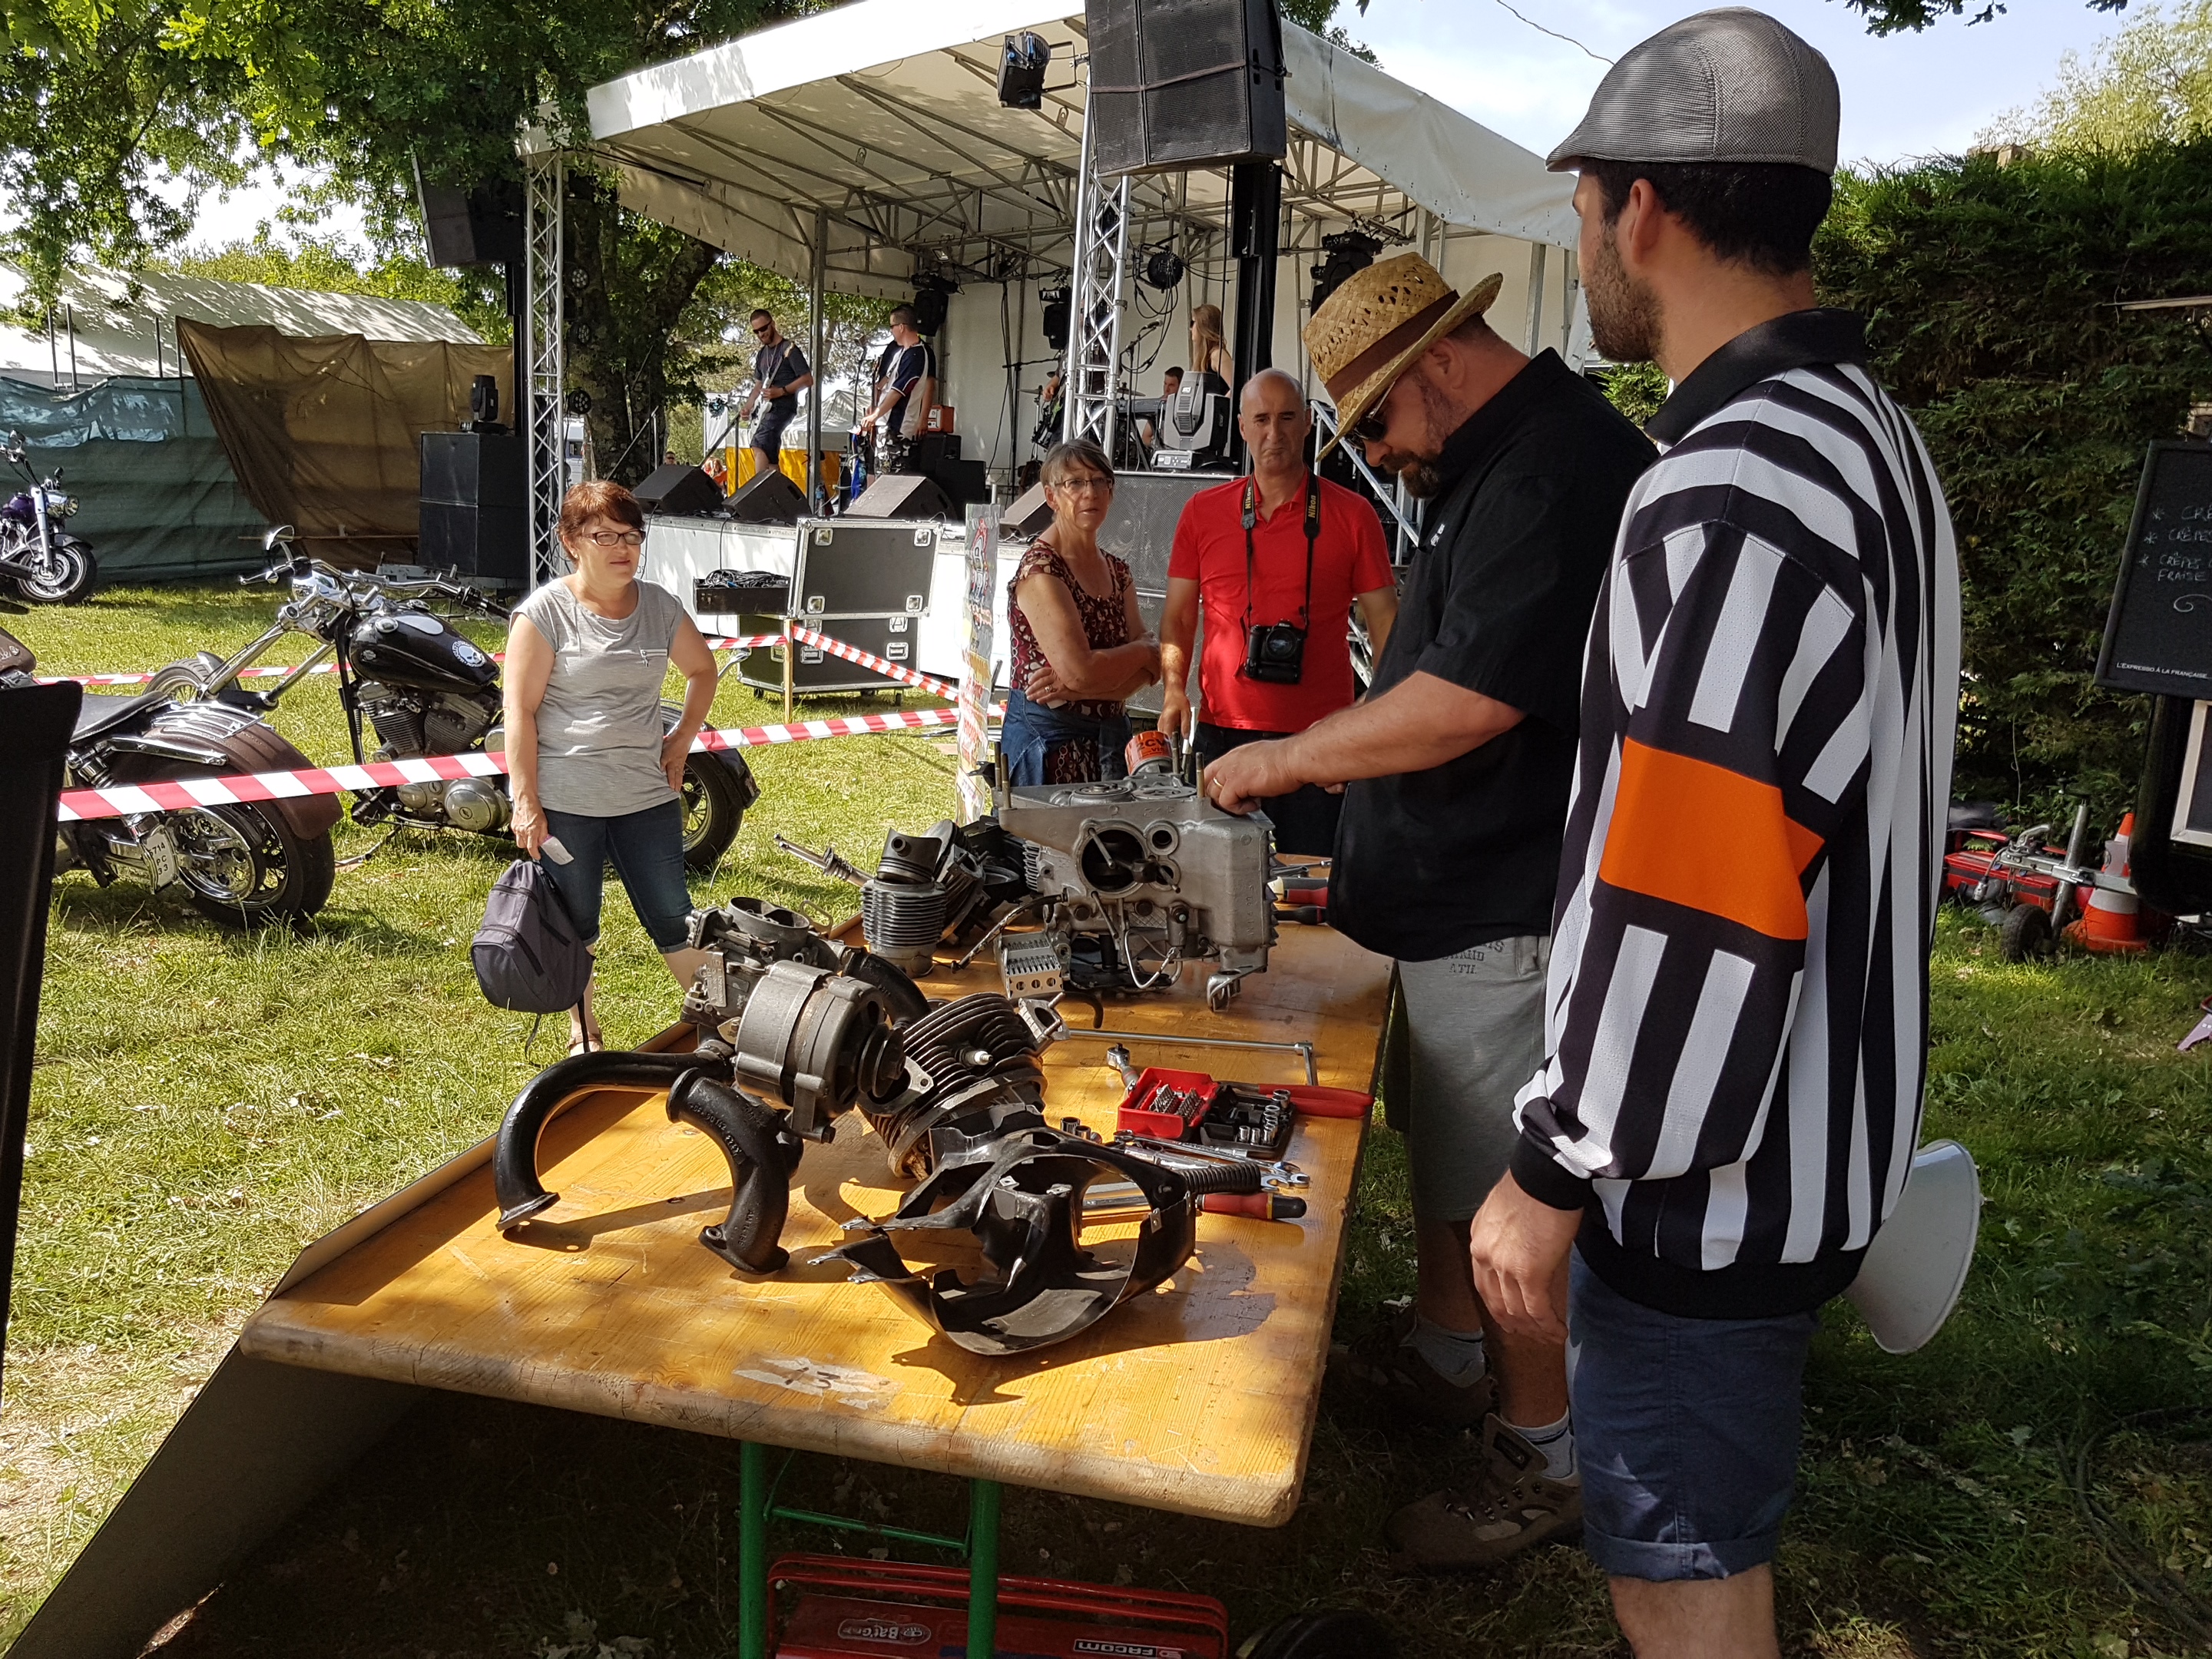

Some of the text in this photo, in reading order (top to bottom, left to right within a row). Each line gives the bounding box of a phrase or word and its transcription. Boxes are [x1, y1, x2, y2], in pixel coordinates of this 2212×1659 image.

[1308, 495, 1316, 518] Nikon
[1137, 739, 1165, 750] 2CV
[156, 855, 167, 866] PC
[157, 863, 169, 876] 33
